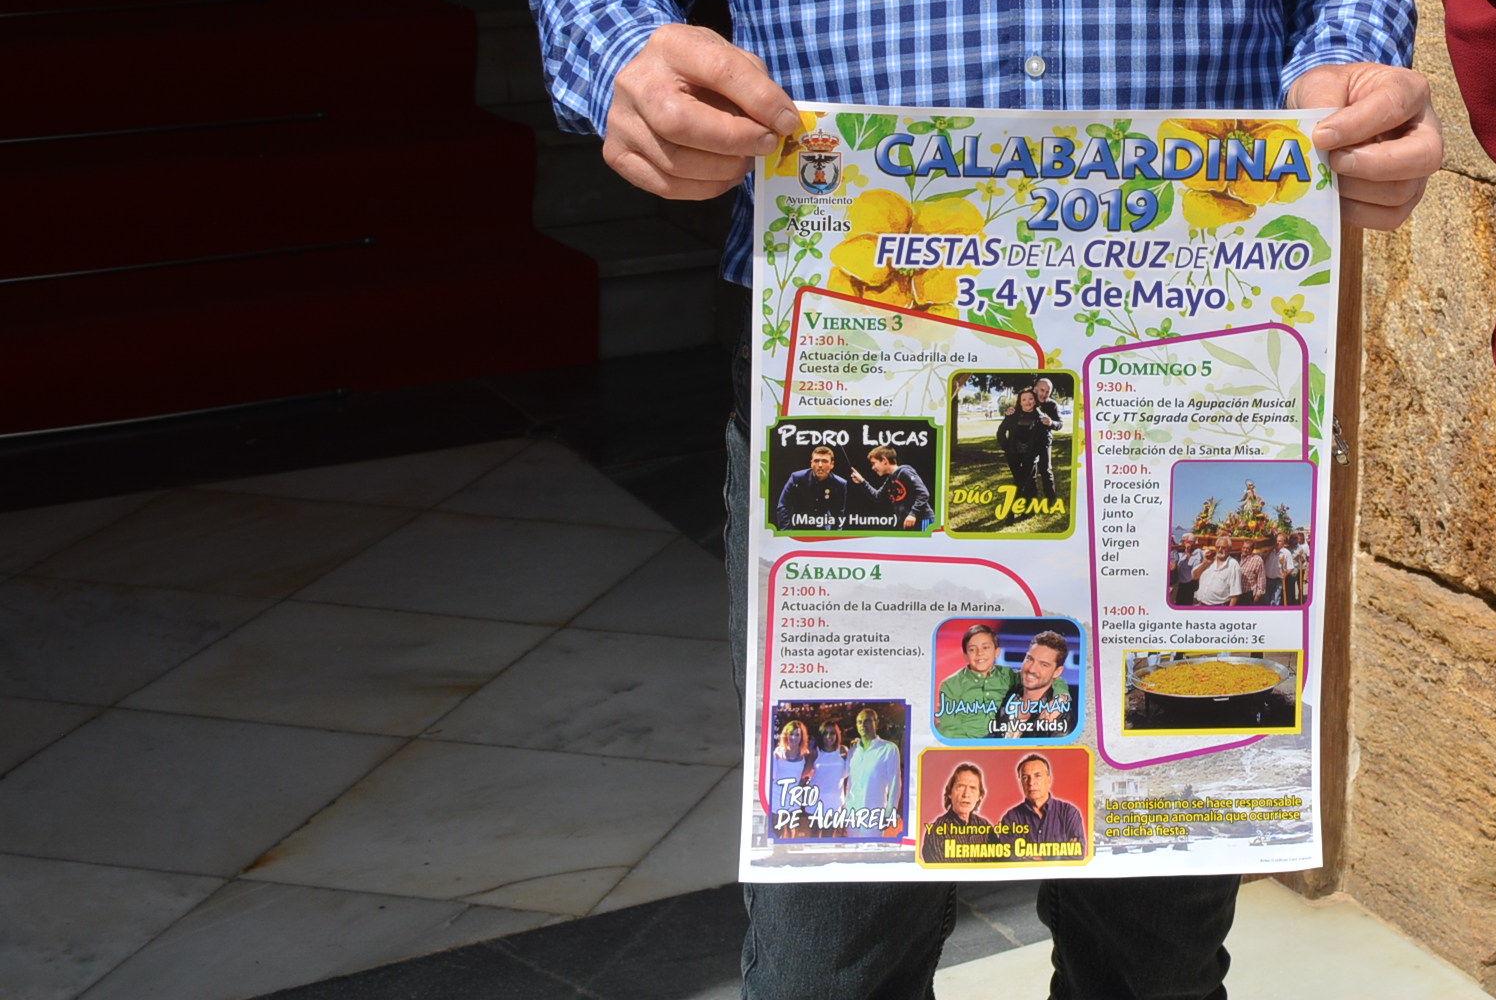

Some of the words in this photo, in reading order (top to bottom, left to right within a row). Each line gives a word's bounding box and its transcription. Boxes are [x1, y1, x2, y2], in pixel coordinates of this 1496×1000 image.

[875, 133, 1311, 182] CALABARDINA
[786, 196, 853, 207] Ayuntamiento
[813, 208, 825, 217] de
[1027, 187, 1160, 233] 2019
[786, 214, 851, 233] Águilas
[877, 237, 1001, 267] FIESTAS
[1008, 243, 1041, 266] DE
[1045, 243, 1076, 266] LA
[1084, 240, 1166, 270] CRUZ
[1176, 247, 1207, 268] DE
[1214, 240, 1310, 269] MAYO
[958, 280, 986, 307] 3,
[997, 280, 1018, 303] 4
[1026, 286, 1044, 315] y
[1056, 280, 1072, 304] 5
[1084, 278, 1121, 307] de
[1132, 280, 1225, 316] Mayo
[892, 315, 902, 330] 3
[800, 335, 834, 346] 21:30
[837, 336, 848, 346] h.
[800, 351, 860, 361] Actuación
[863, 352, 878, 361] de
[881, 352, 890, 361] la
[894, 352, 946, 362] Cuadrilla
[950, 352, 964, 362] de
[968, 352, 978, 362] la
[800, 364, 839, 374] Cuesta
[842, 364, 857, 374] de
[861, 364, 886, 374] Gos.
[1201, 361, 1211, 376] 5
[1096, 397, 1153, 407] Actuación
[1158, 398, 1171, 407] de
[1175, 398, 1184, 407] la
[1187, 398, 1249, 410] Agupación
[1252, 398, 1295, 408] Musical
[1096, 412, 1110, 421] CC
[1114, 414, 1120, 423] y
[1123, 413, 1137, 422] TT
[1139, 413, 1188, 424] Sagrada
[1191, 413, 1232, 422] Corona
[1235, 413, 1248, 422] de
[1252, 413, 1298, 424] Espinas.
[1098, 445, 1164, 455] Celebración
[1169, 446, 1183, 455] de
[1186, 446, 1195, 455] la
[1199, 446, 1231, 455] Santa
[1234, 446, 1264, 456] Misa.
[1104, 479, 1159, 489] Procesión
[792, 514, 835, 526] (Magia
[838, 516, 846, 527] y
[850, 513, 898, 527] Humor)
[1102, 538, 1139, 549] Virgen
[870, 565, 881, 579] 4
[1101, 567, 1149, 576] Carmen.
[1102, 621, 1135, 630] Paella
[1139, 621, 1182, 633] gigante
[1186, 621, 1216, 630] hasta
[1219, 623, 1257, 633] agotar
[781, 633, 840, 643] Sardinada
[843, 633, 890, 646] gratuita
[1101, 636, 1166, 644] existencias.
[1170, 635, 1248, 644] Colaboración:
[1251, 635, 1265, 644] 3€
[781, 647, 813, 657] (hasta
[817, 648, 854, 658] agotar
[857, 647, 925, 658] existencias).
[1106, 798, 1118, 809] La
[1122, 799, 1171, 809] comisión
[1175, 800, 1189, 809] no
[1192, 800, 1204, 808] se
[1206, 797, 1232, 808] hace
[1235, 796, 1301, 809] responsable
[775, 809, 800, 829] DE
[1106, 813, 1120, 823] de
[1123, 813, 1169, 826] ninguna
[1226, 812, 1247, 824] que
[1250, 810, 1300, 820] ocurriese
[1106, 828, 1120, 837] en
[1123, 826, 1153, 836] dicha
[1156, 826, 1188, 836] fiesta.
[945, 839, 1011, 858] HERMANOS
[1015, 838, 1082, 857] CALATRAVA
